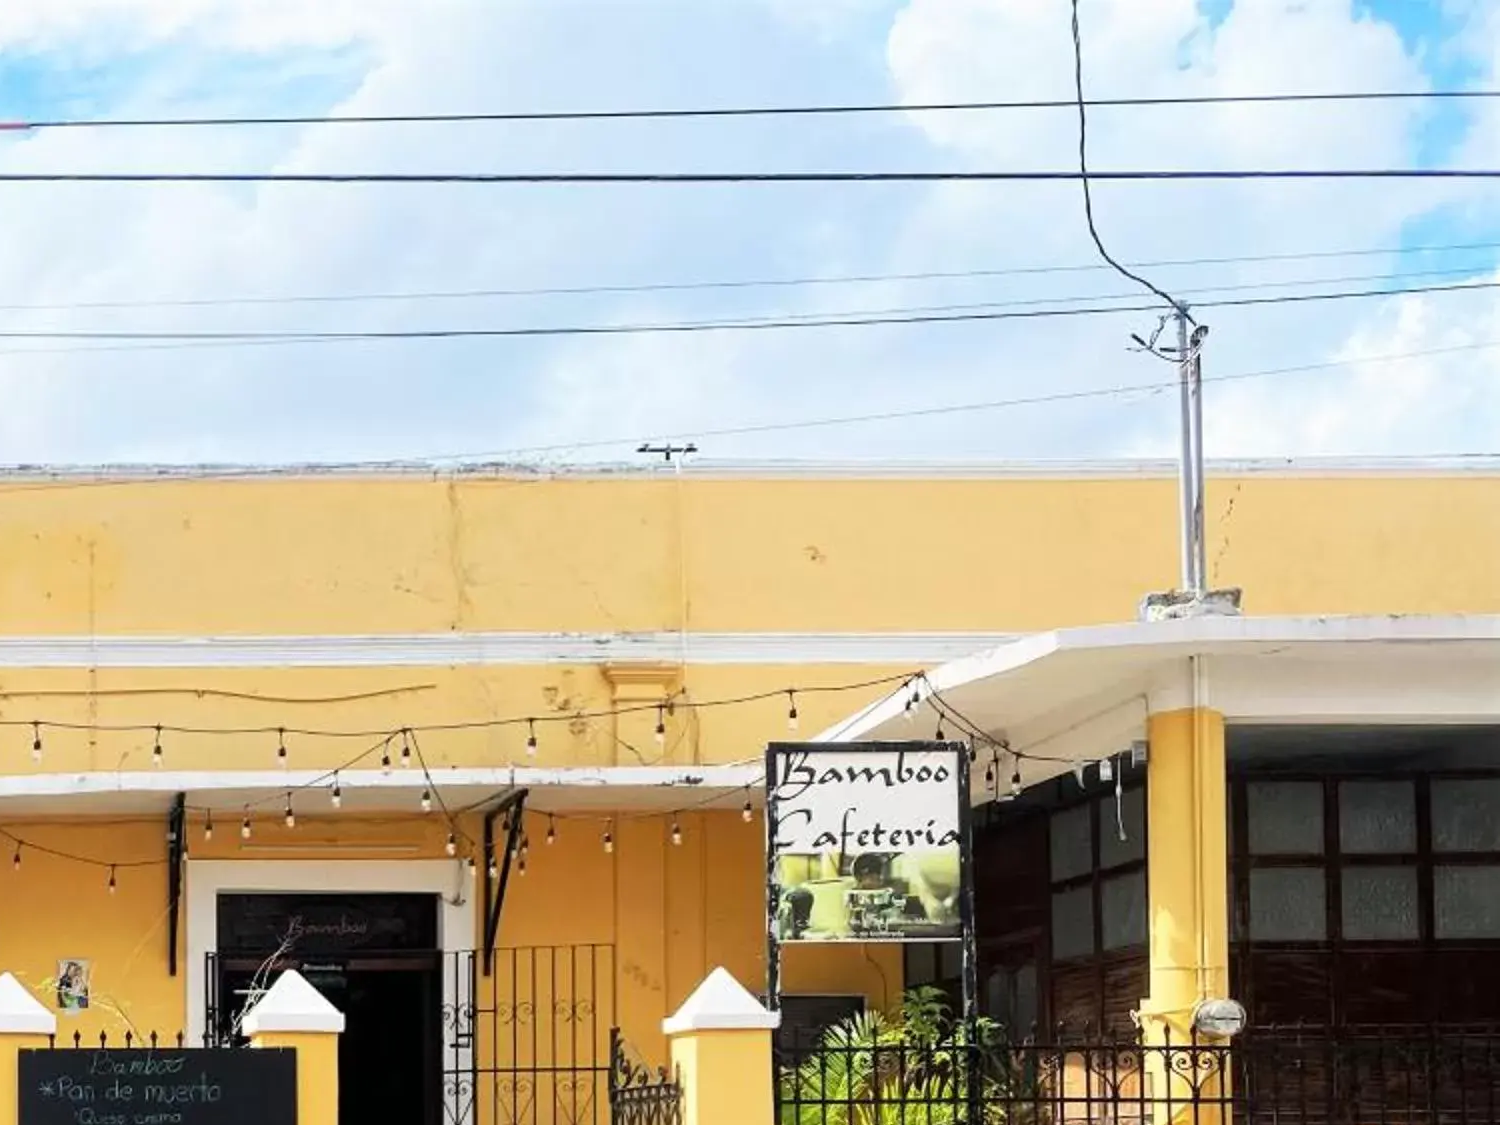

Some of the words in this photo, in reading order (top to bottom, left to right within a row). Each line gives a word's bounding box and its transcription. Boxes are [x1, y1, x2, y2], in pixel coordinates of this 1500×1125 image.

[773, 751, 950, 801] Bamboo
[90, 1050, 186, 1077] Bamboo
[105, 1079, 134, 1102] de
[144, 1072, 222, 1103] muerto
